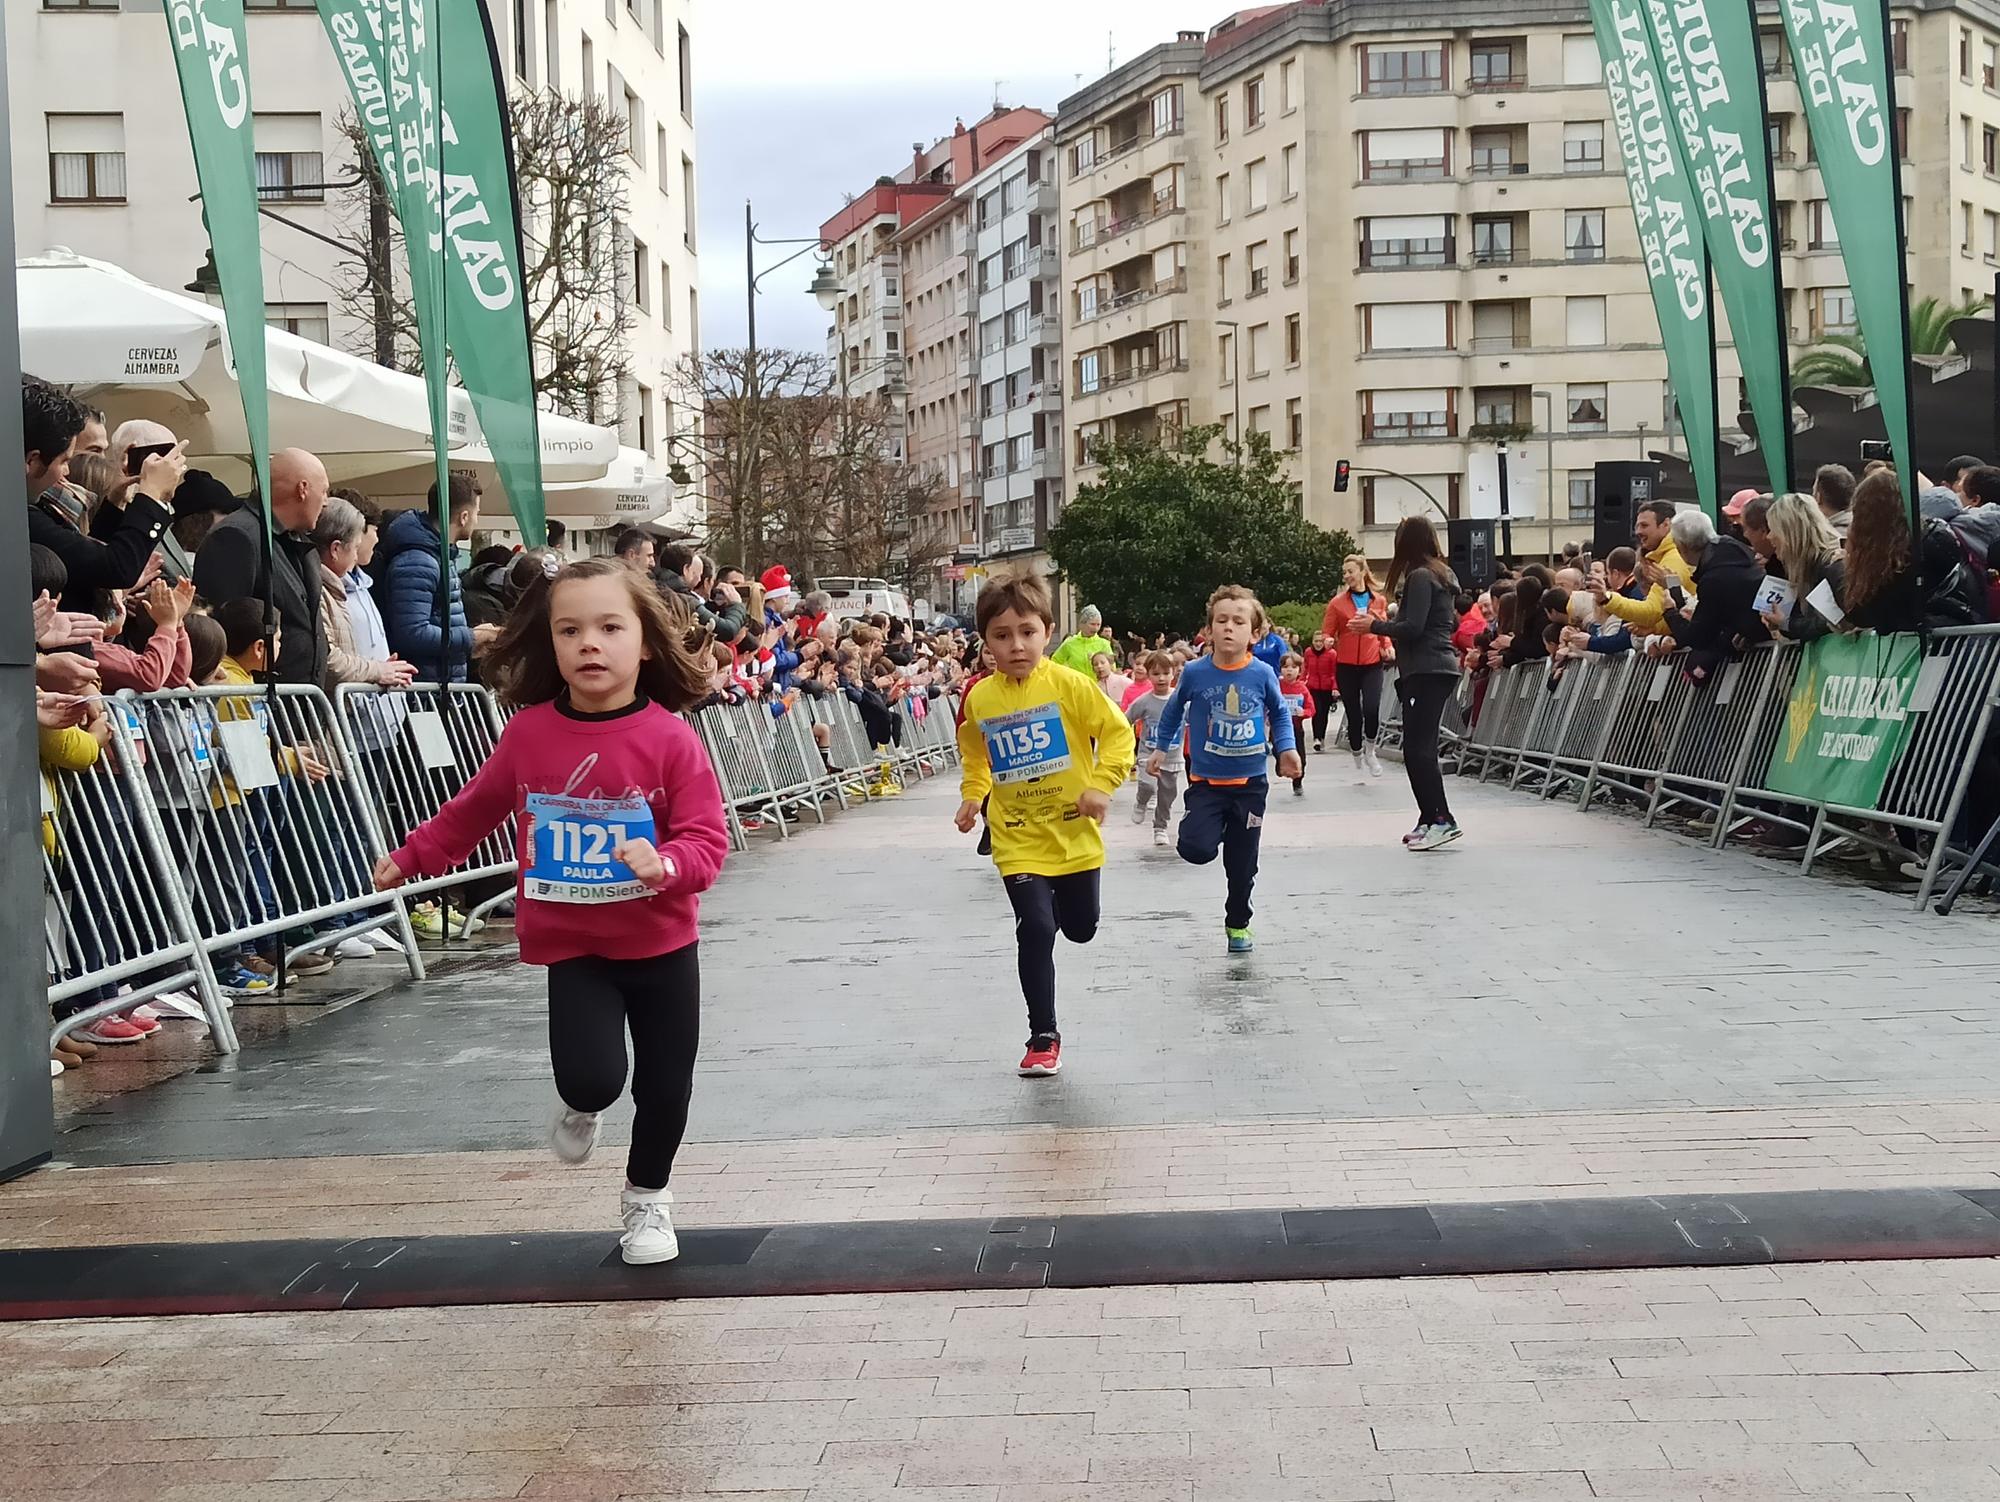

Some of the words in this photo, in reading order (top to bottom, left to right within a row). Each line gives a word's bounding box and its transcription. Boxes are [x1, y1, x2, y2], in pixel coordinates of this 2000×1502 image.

[128, 348, 178, 360] CERVEZAS
[124, 363, 180, 375] ALHAMBRA
[543, 438, 594, 454] limpio
[617, 494, 649, 503] CERVEZAS
[1217, 719, 1256, 740] 1128
[992, 721, 1051, 758] 1135
[1008, 752, 1043, 767] MARCO
[1016, 761, 1064, 778] PDMSiero
[1015, 786, 1063, 799] Atletismo
[538, 797, 582, 810] CARRERA
[549, 820, 628, 864] 1121
[563, 866, 614, 879] PAULA
[569, 884, 645, 898] PDMSiero
